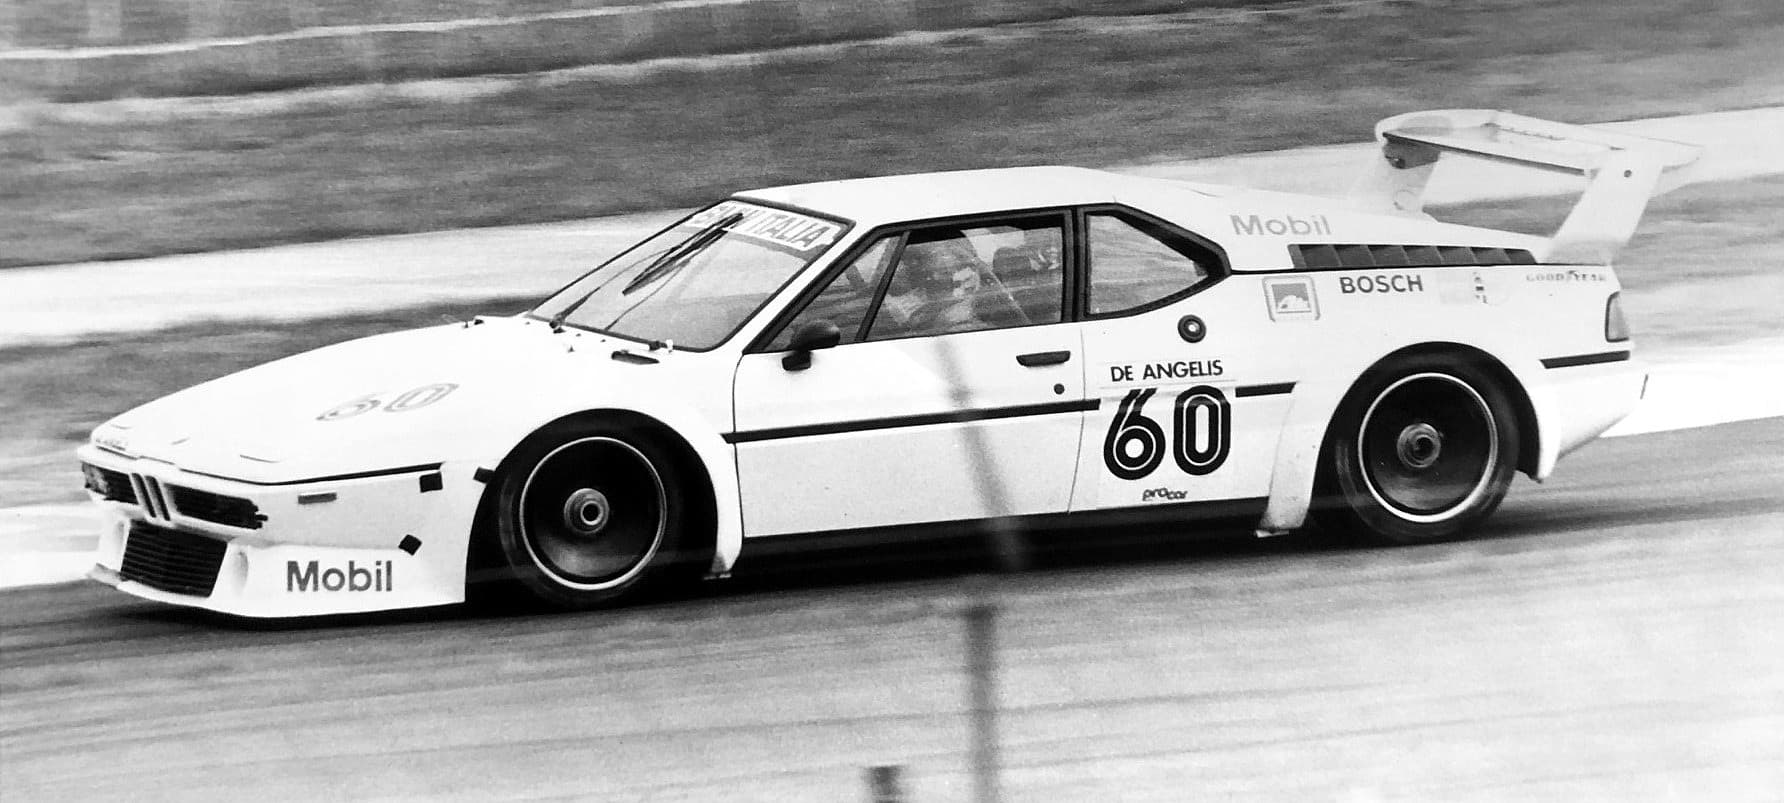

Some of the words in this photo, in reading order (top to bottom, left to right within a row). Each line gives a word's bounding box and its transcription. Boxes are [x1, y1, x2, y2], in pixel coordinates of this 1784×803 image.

[747, 213, 830, 248] ITALIA
[1231, 215, 1331, 236] Mobil
[1341, 275, 1424, 295] BOSCH
[1110, 366, 1134, 382] DE
[1143, 360, 1223, 380] ANGELIS
[315, 383, 460, 421] 60
[1104, 385, 1231, 480] 60
[287, 560, 393, 592] Mobil
